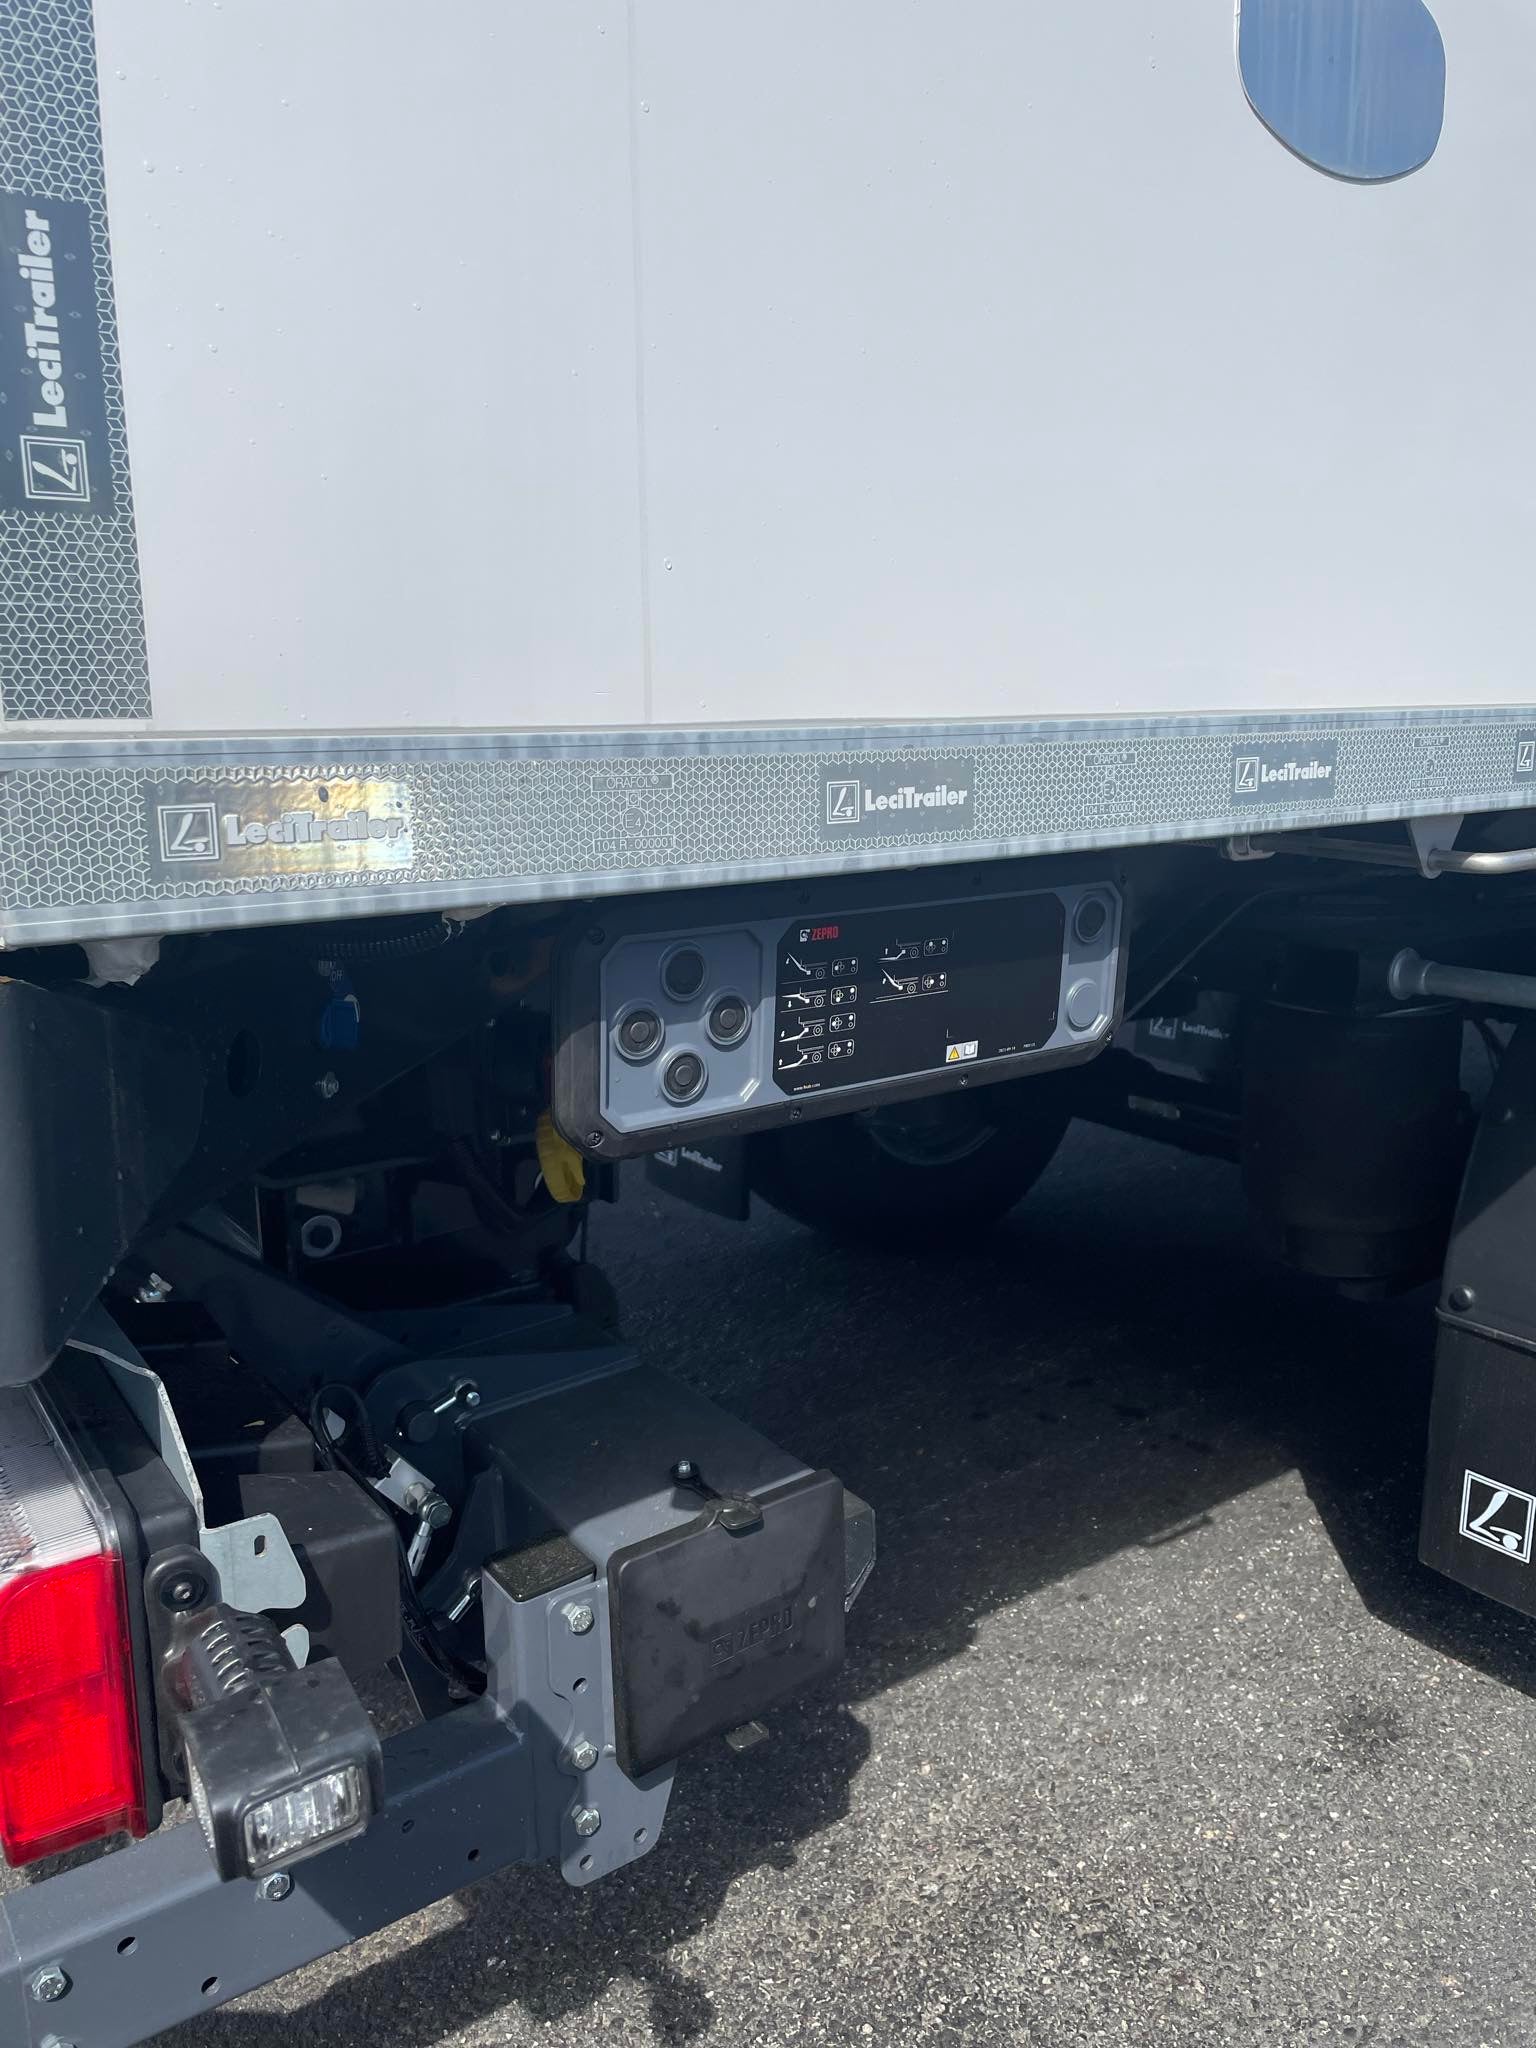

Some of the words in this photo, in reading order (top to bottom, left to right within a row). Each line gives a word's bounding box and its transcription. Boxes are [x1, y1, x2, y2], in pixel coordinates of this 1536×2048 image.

[17, 209, 68, 428] LeciTrailer
[1261, 760, 1333, 783] LeciTrailer
[864, 784, 968, 812] LeciTrailer
[223, 810, 405, 846] LeciTrailer
[625, 812, 642, 829] E4
[597, 840, 617, 852] 104
[811, 926, 840, 941] ZEPRO
